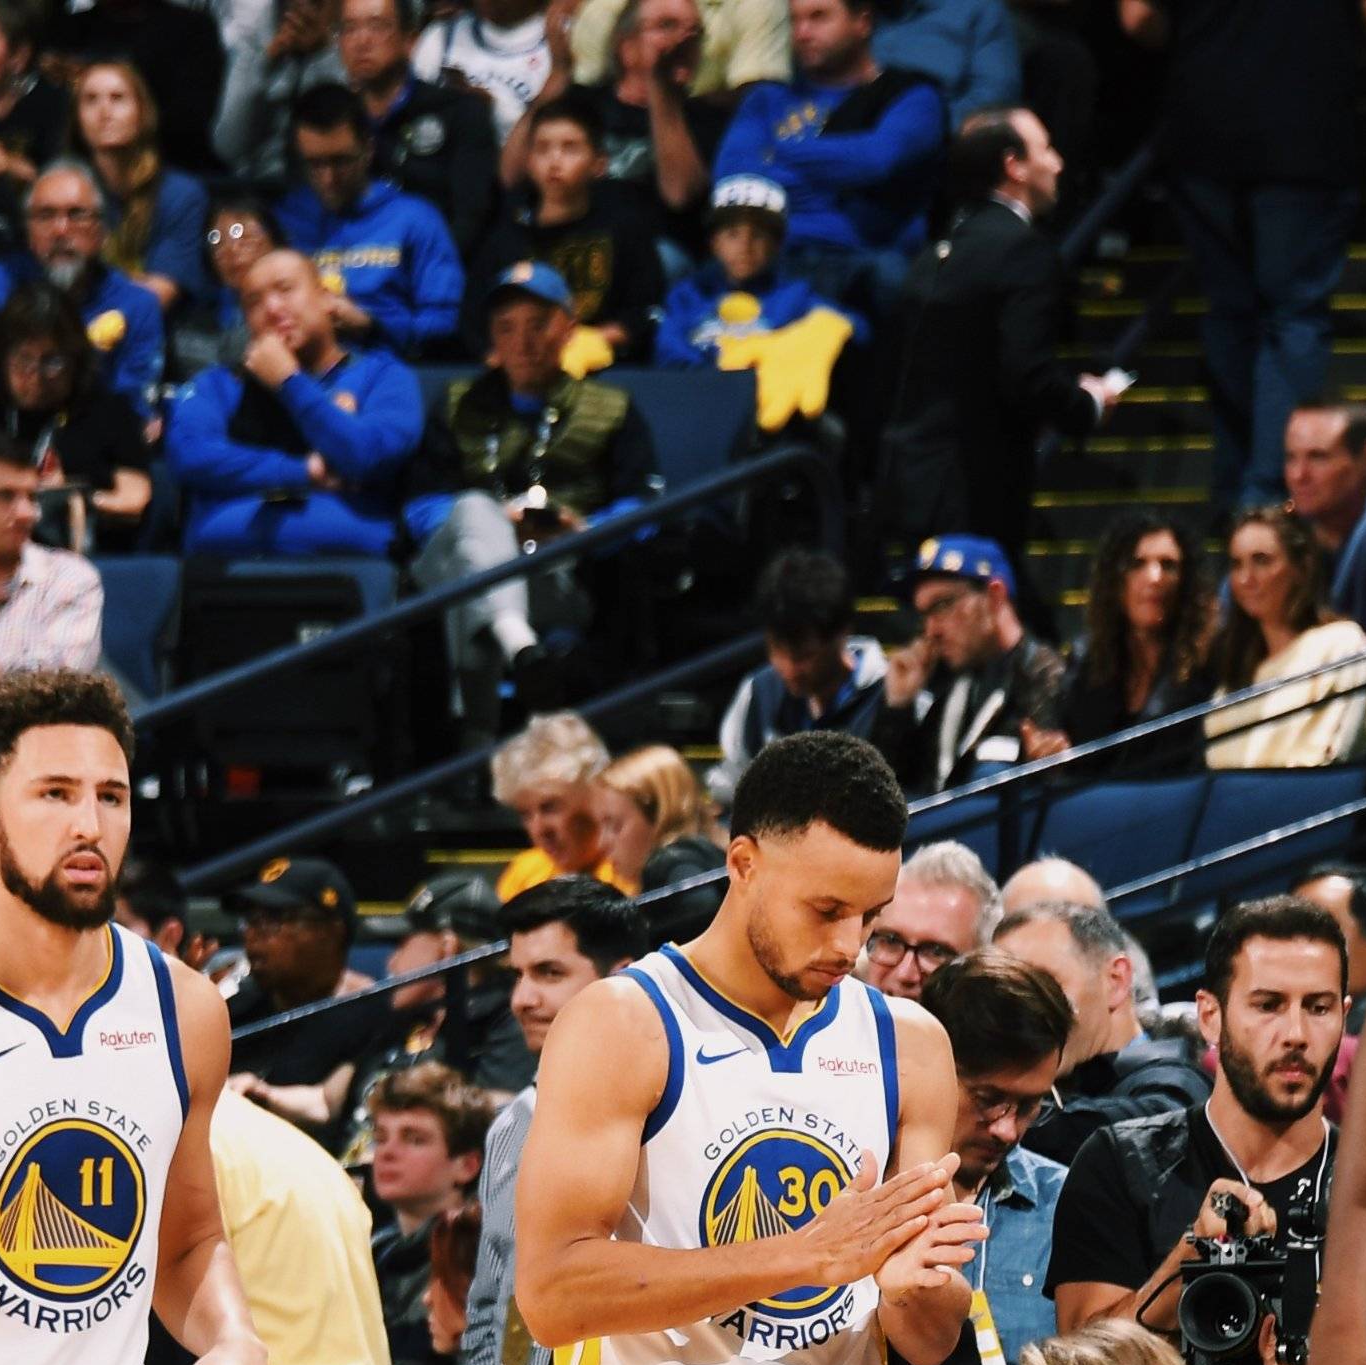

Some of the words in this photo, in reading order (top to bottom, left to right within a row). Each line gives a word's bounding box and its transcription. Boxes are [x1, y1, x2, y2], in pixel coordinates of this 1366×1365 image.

[99, 1029, 157, 1048] Rakuten
[817, 1055, 878, 1075] Rakuten
[87, 1100, 153, 1153] STATE
[703, 1106, 795, 1161] GOLDEN
[804, 1112, 865, 1172] STATE
[78, 1156, 115, 1207] 11
[777, 1165, 841, 1218] 30
[711, 1288, 855, 1351] ARRIORS
